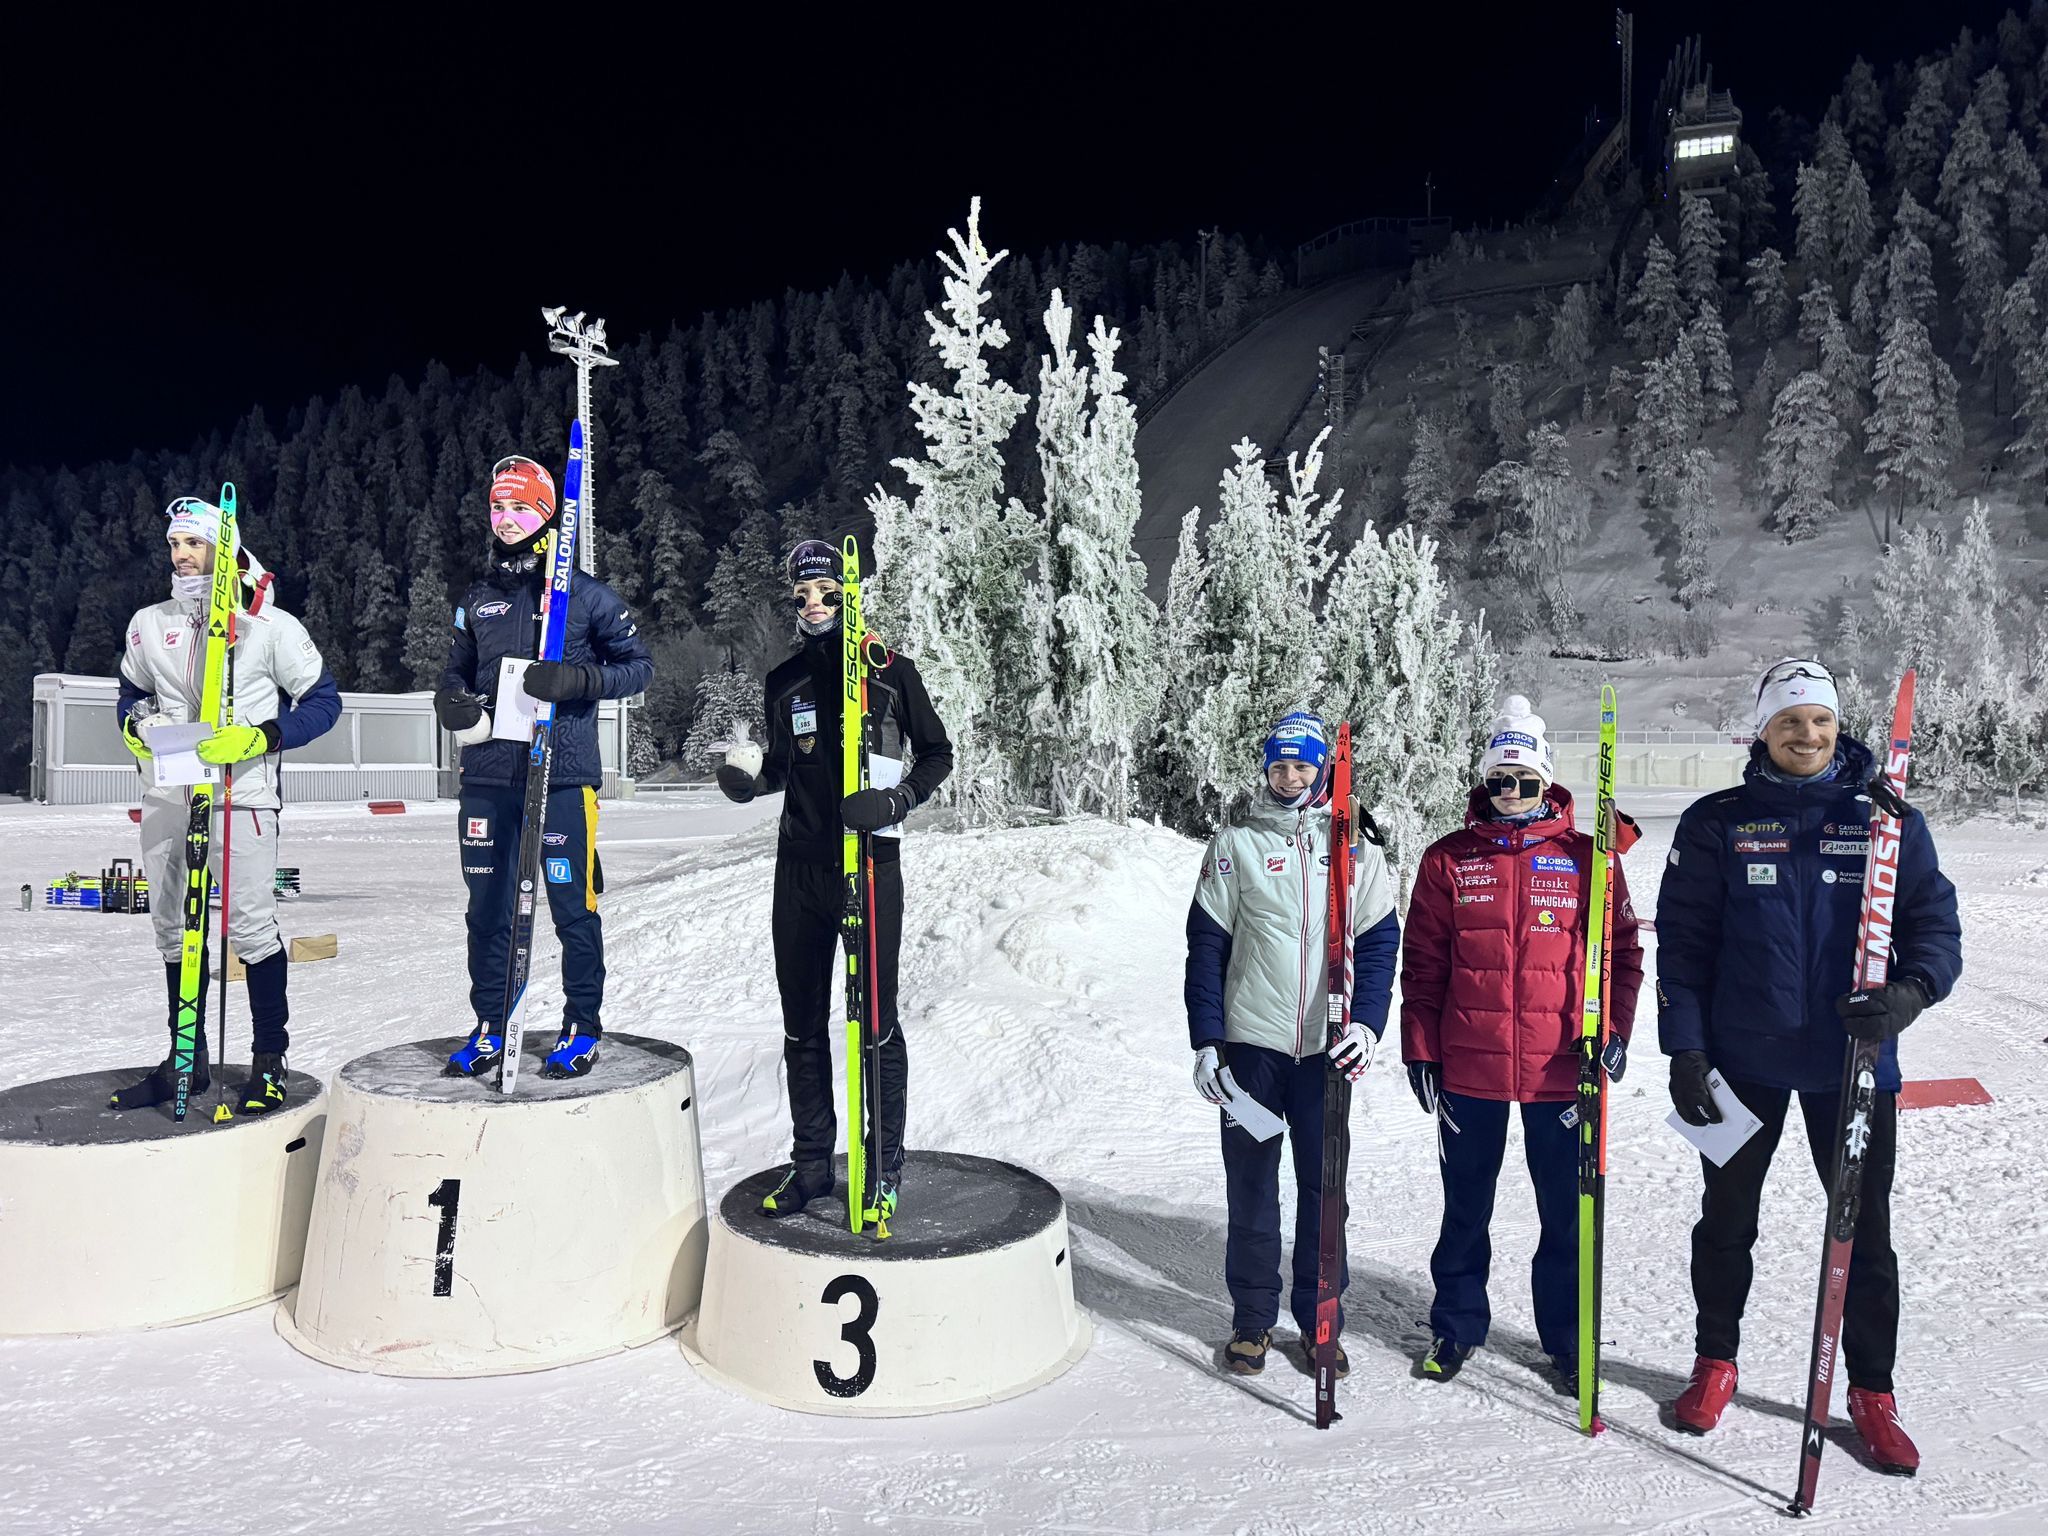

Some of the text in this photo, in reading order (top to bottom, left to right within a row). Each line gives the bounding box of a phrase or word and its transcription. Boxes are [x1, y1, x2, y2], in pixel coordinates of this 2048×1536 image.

[554, 498, 577, 592] SALOMON
[214, 510, 233, 611] FISCHER
[532, 613, 543, 621] Ka
[846, 592, 857, 702] FISCHER
[1507, 732, 1534, 743] OBOS
[540, 746, 553, 825] SALOMON
[1336, 808, 1344, 847] ATOMIC
[1736, 822, 1787, 834] somfy
[462, 838, 494, 847] Kaufland
[1833, 843, 1857, 851] Jean
[1548, 858, 1574, 866] OBOS
[549, 861, 568, 880] TQ
[1455, 864, 1485, 873] CRAFT
[1839, 871, 1865, 879] Auverg
[1465, 877, 1498, 887] KRAFT
[1458, 894, 1494, 904] VEFLEN
[1530, 895, 1578, 909] THAUGLAND
[428, 1179, 462, 1297] 1
[1832, 1267, 1845, 1277] 192
[813, 1275, 879, 1398] 3
[1817, 1333, 1833, 1384] REDLINE
